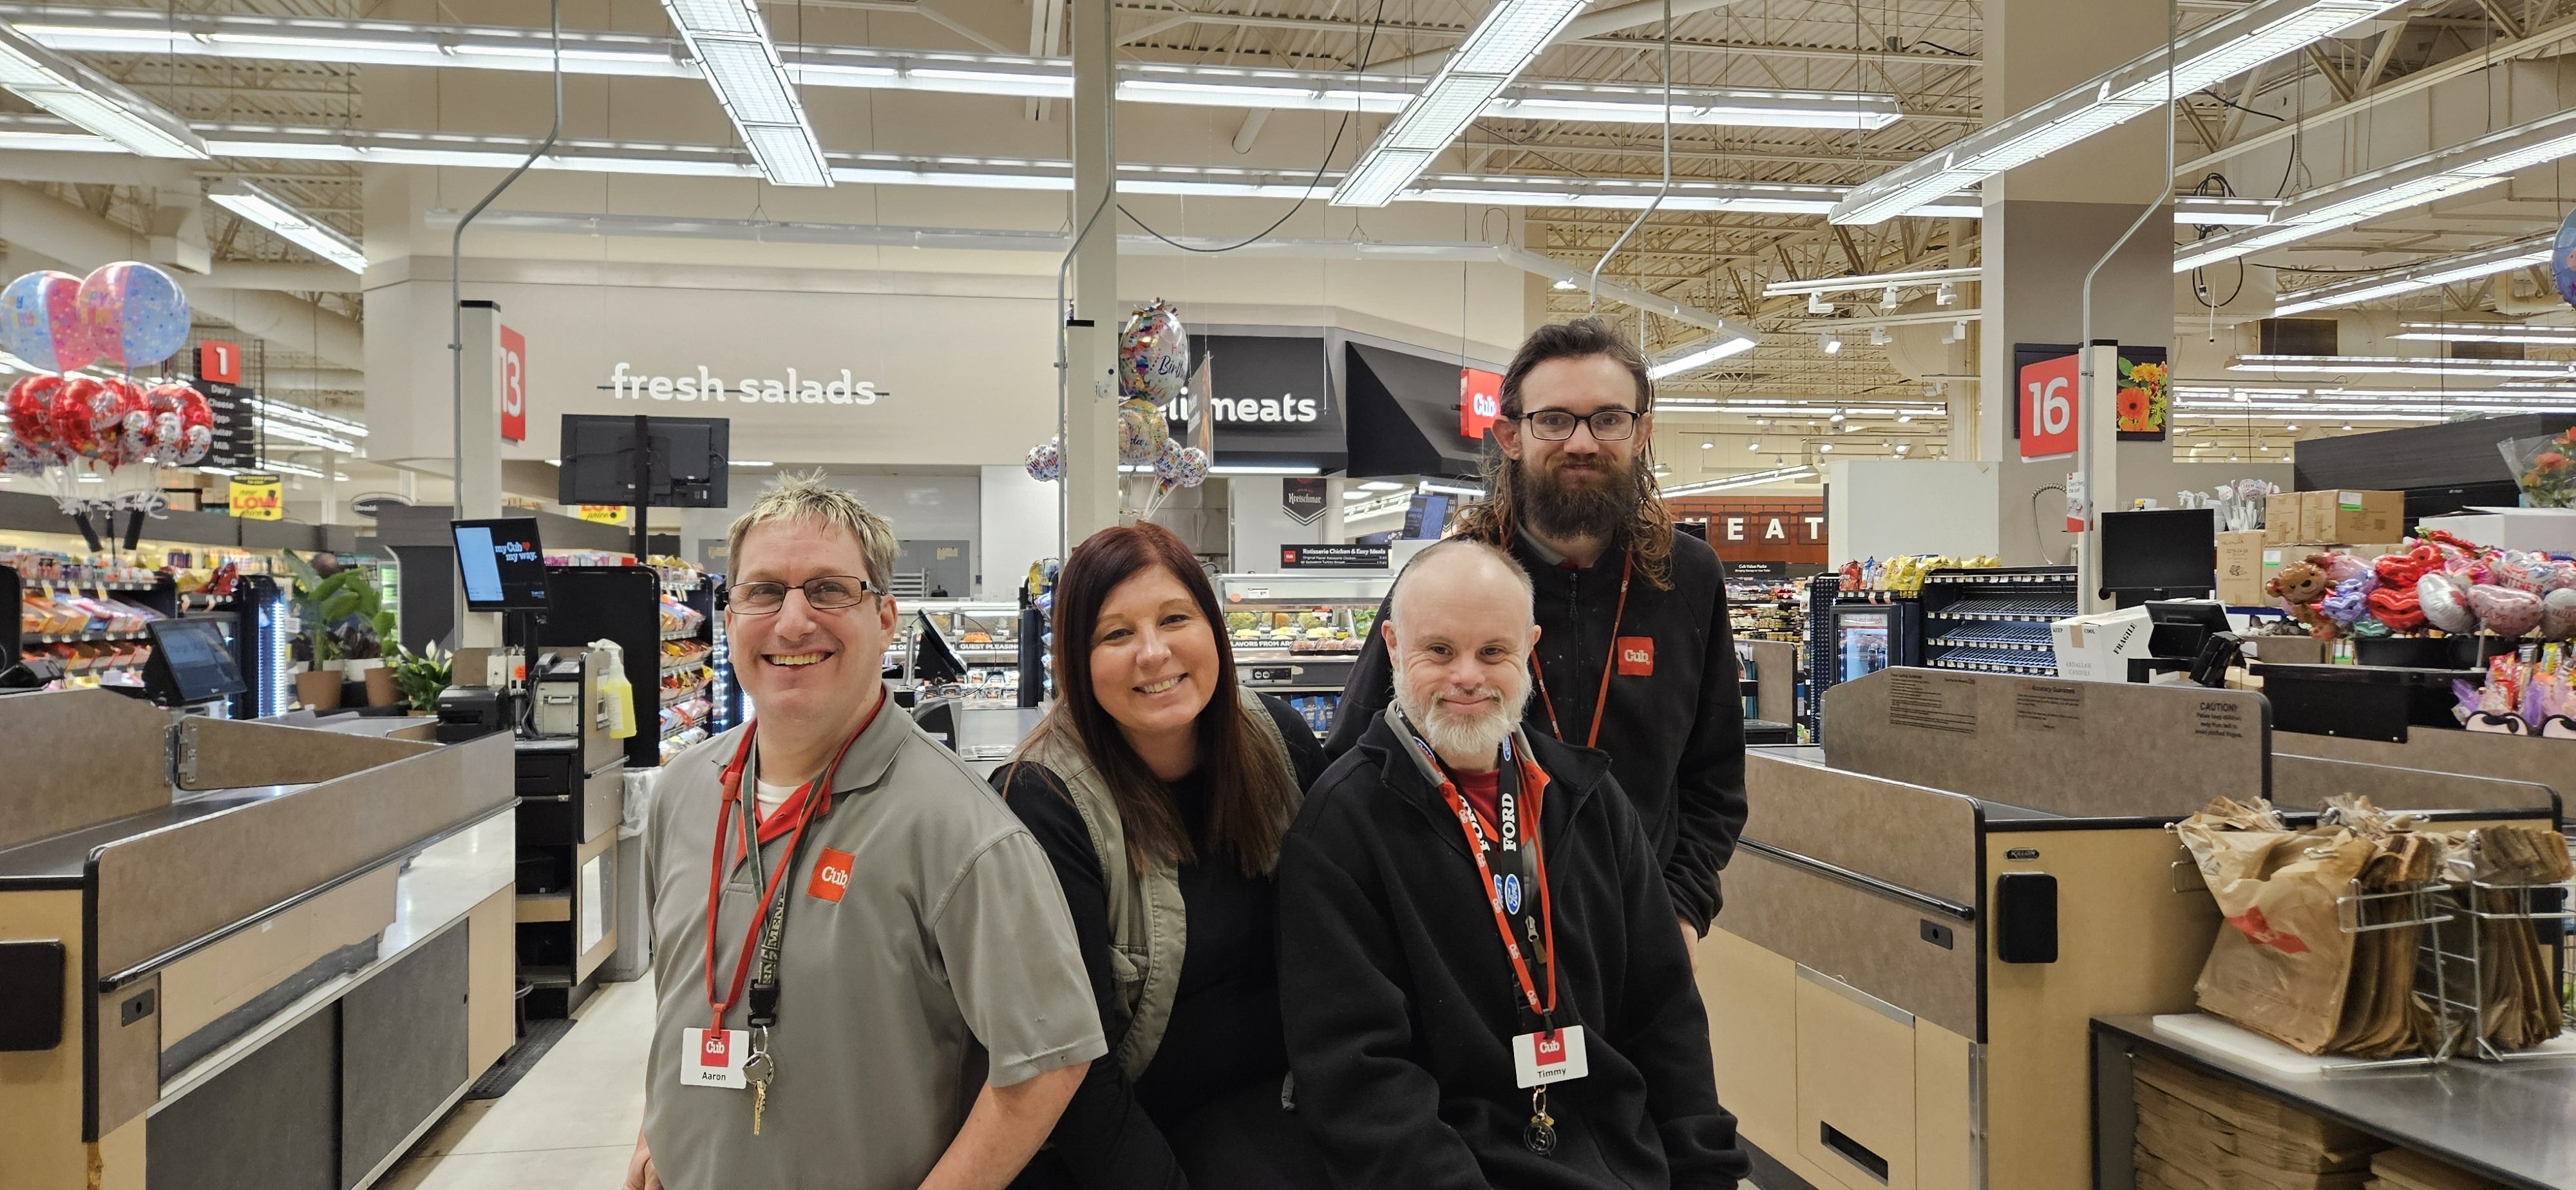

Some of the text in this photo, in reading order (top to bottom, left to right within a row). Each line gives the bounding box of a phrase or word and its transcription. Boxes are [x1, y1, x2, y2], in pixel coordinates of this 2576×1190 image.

[215, 346, 229, 376] 1
[500, 346, 521, 418] 13
[611, 362, 876, 405] fresh salads
[211, 384, 232, 396] Dairy
[207, 397, 235, 410] Cheese
[1211, 393, 1317, 422] meats
[1473, 392, 1496, 418] Cub
[2028, 377, 2070, 437] 16
[214, 440, 229, 451] Milk
[213, 455, 236, 466] Yogurt
[233, 496, 278, 509] LOW
[506, 551, 537, 562] my way.
[2113, 622, 2137, 655] FRAGILE
[1624, 649, 1649, 663] Cub
[1502, 793, 1517, 851] FORD
[821, 866, 848, 888] Cub
[706, 1041, 725, 1055] Cub
[1539, 1040, 1560, 1053] Cub
[701, 1072, 726, 1082] Aaron
[1537, 1068, 1567, 1079] Timmy
